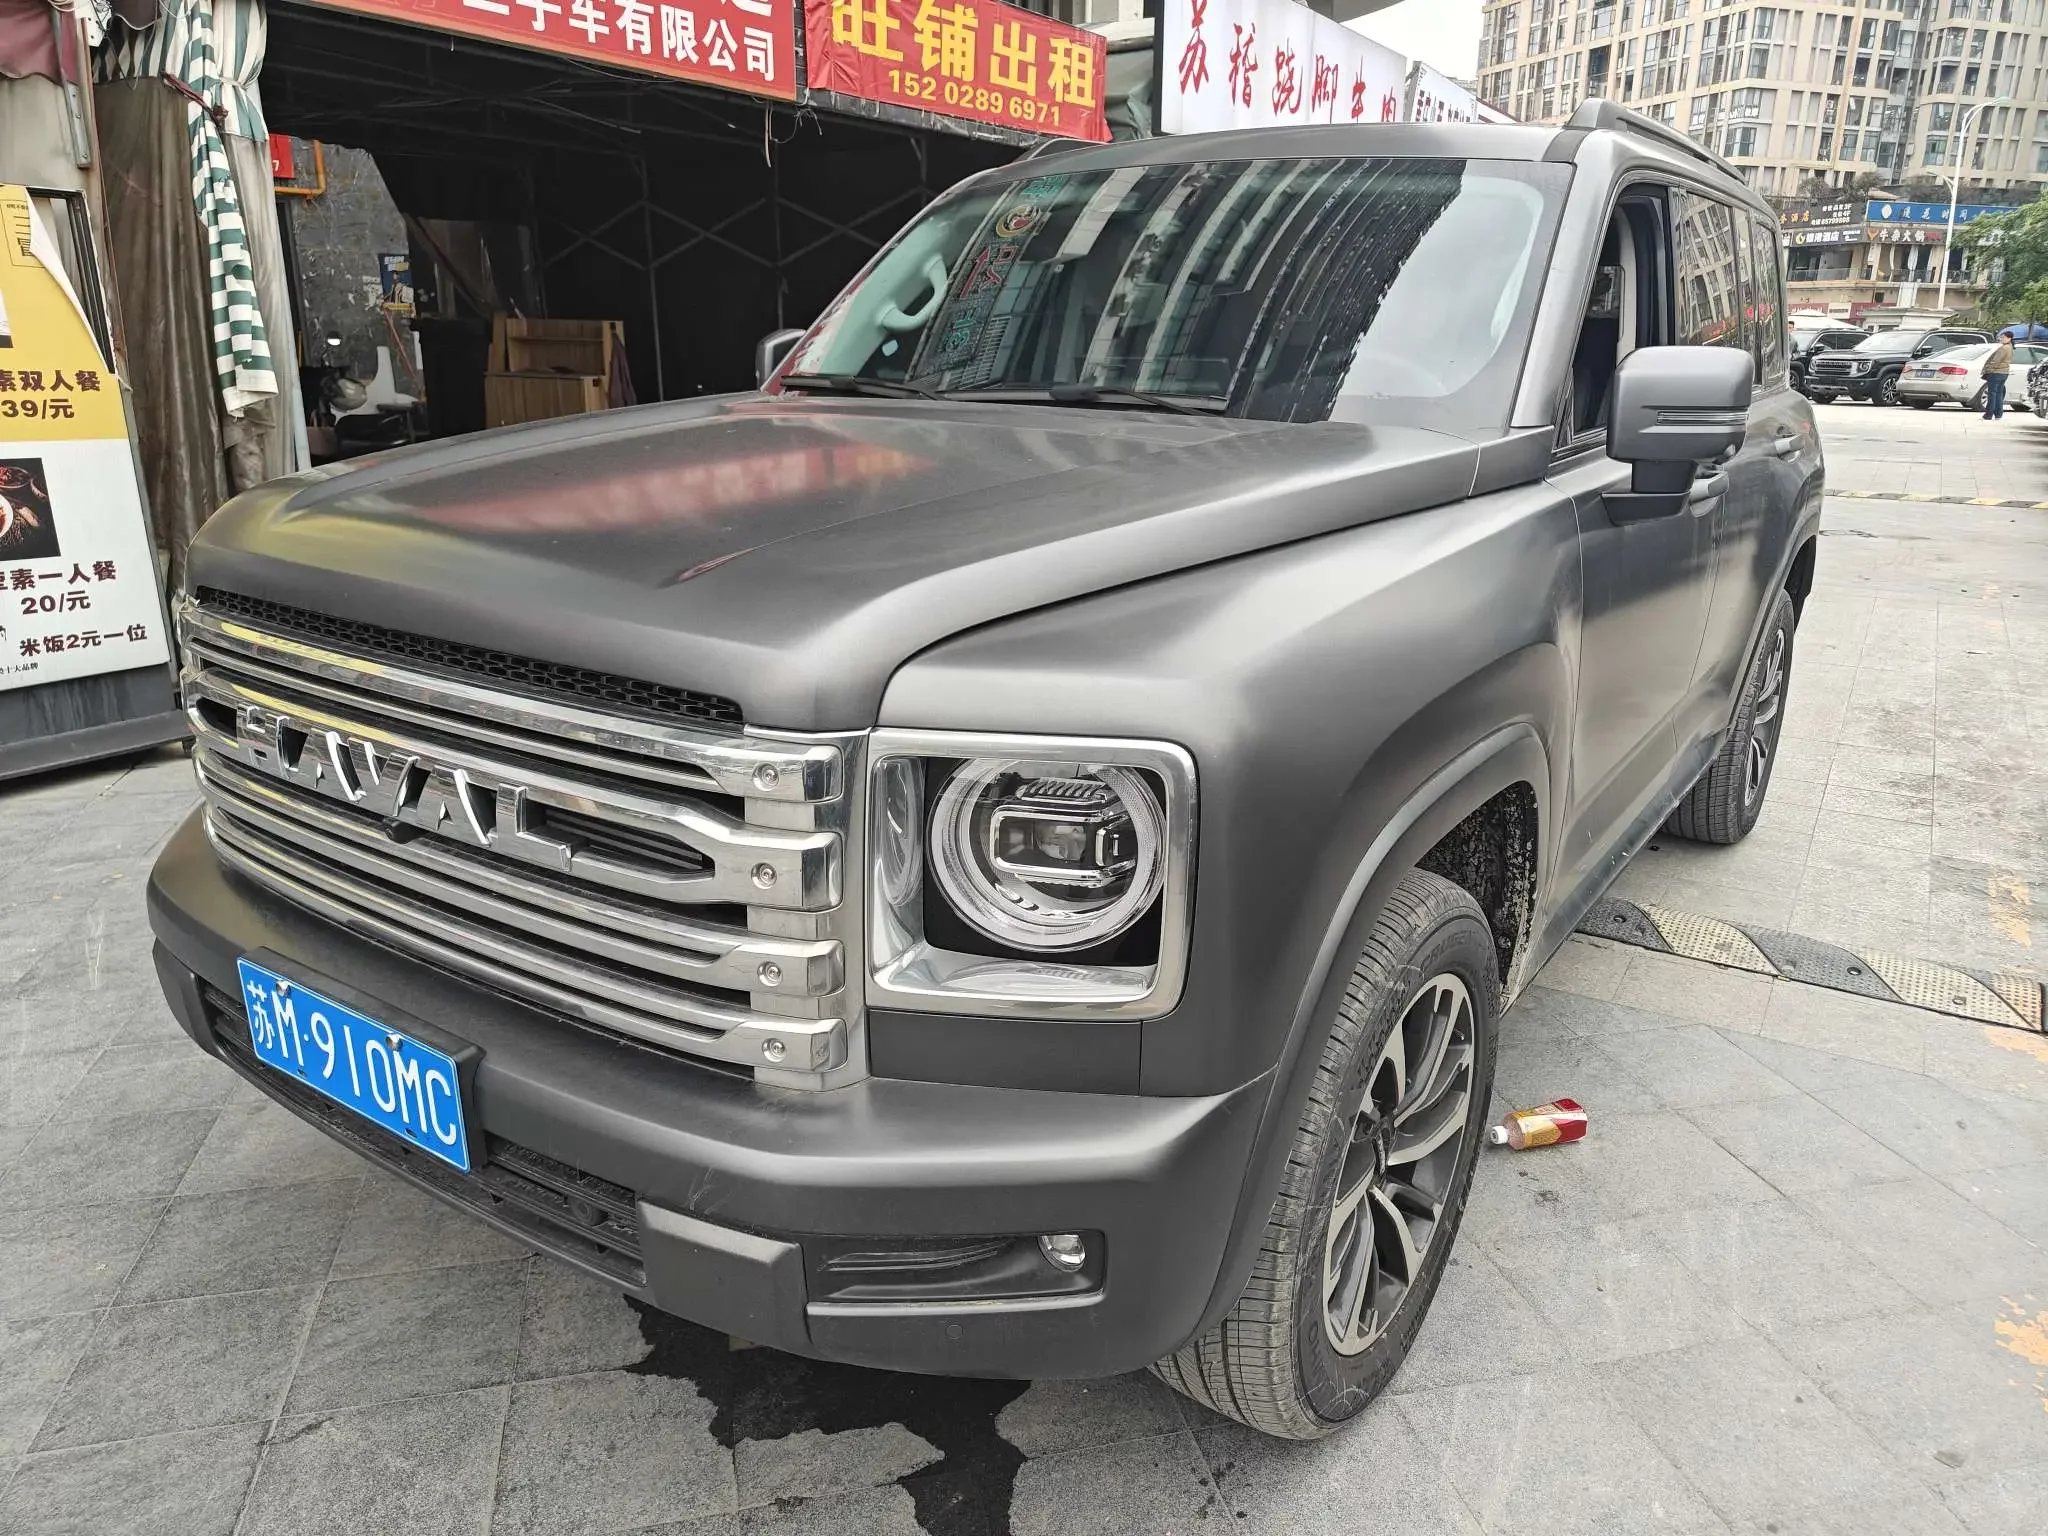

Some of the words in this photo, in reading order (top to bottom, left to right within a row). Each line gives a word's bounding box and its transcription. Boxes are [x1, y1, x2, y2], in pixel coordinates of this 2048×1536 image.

[832, 0, 1096, 107] 旺铺出租
[889, 69, 937, 101] 152
[944, 81, 1003, 113] 0289
[1009, 96, 1060, 126] 6971
[2, 399, 75, 420] 39/元
[21, 590, 91, 615] 20/元
[20, 624, 148, 657] 米饭2元一位
[237, 703, 573, 871] HAVAL
